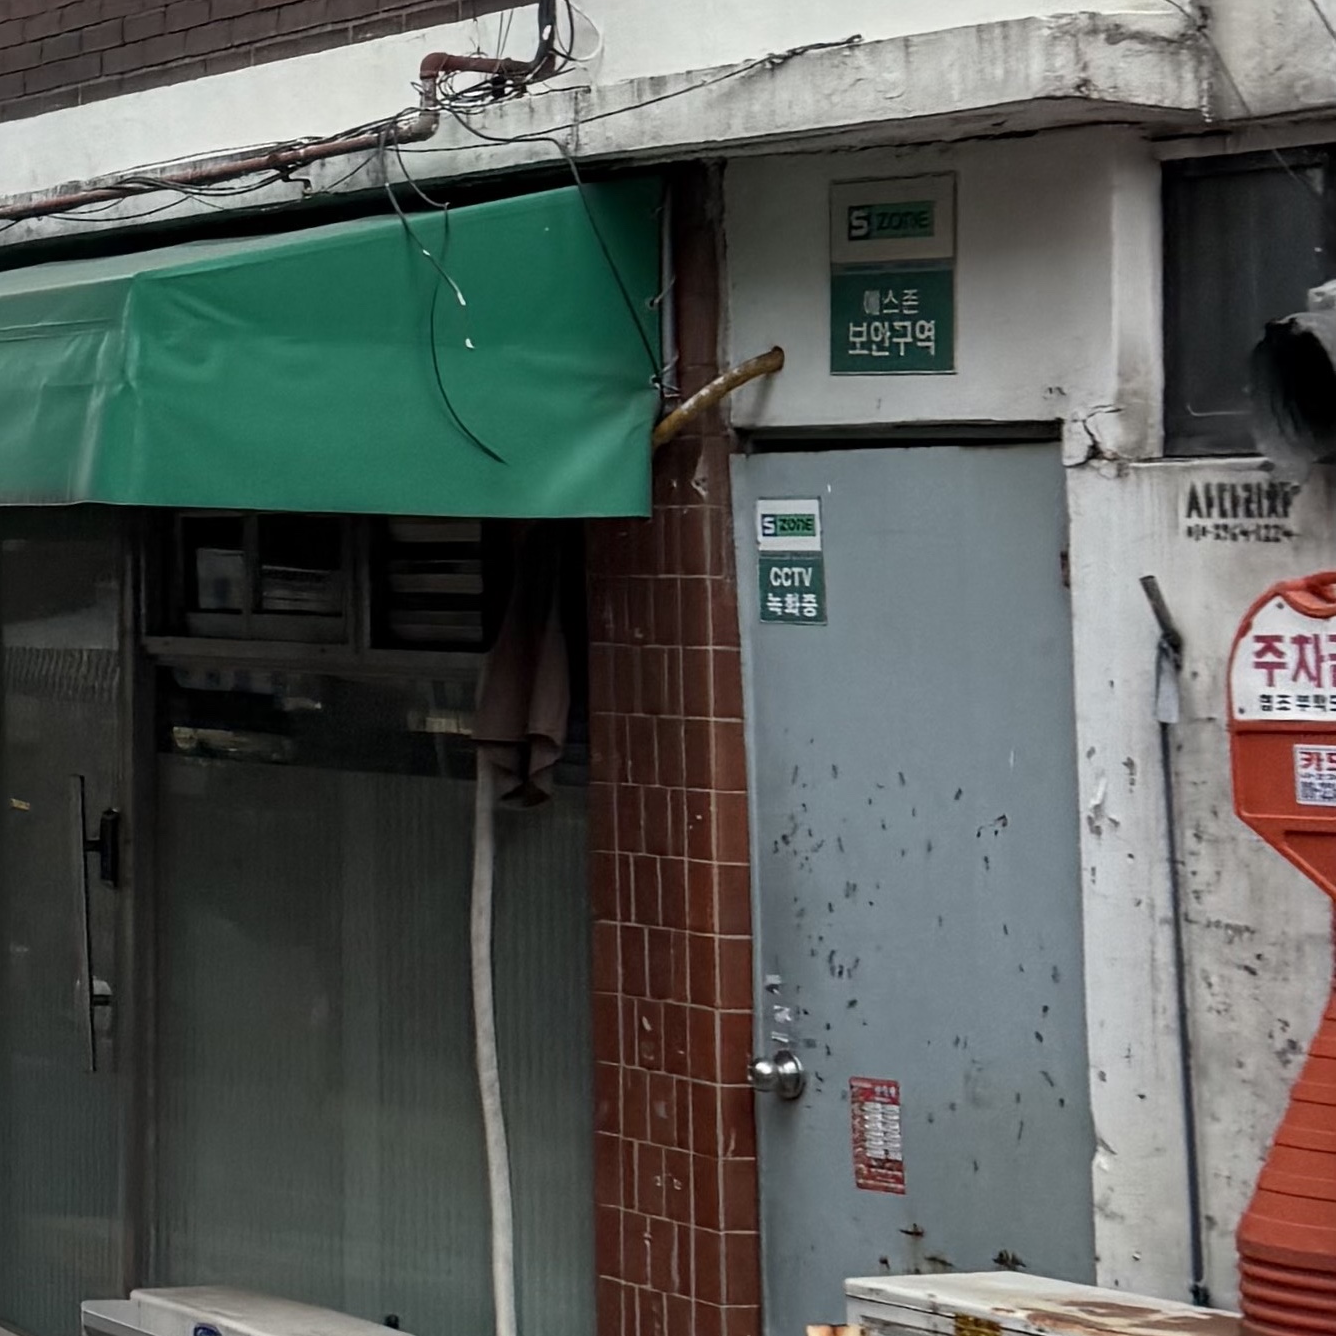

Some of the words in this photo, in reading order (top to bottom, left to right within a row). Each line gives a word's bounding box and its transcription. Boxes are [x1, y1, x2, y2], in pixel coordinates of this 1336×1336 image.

[848, 319, 936, 356] 보안구역
[763, 516, 776, 535] S
[778, 518, 813, 532] ZONE
[769, 566, 813, 587] CCTV
[766, 592, 819, 618] 녹화중
